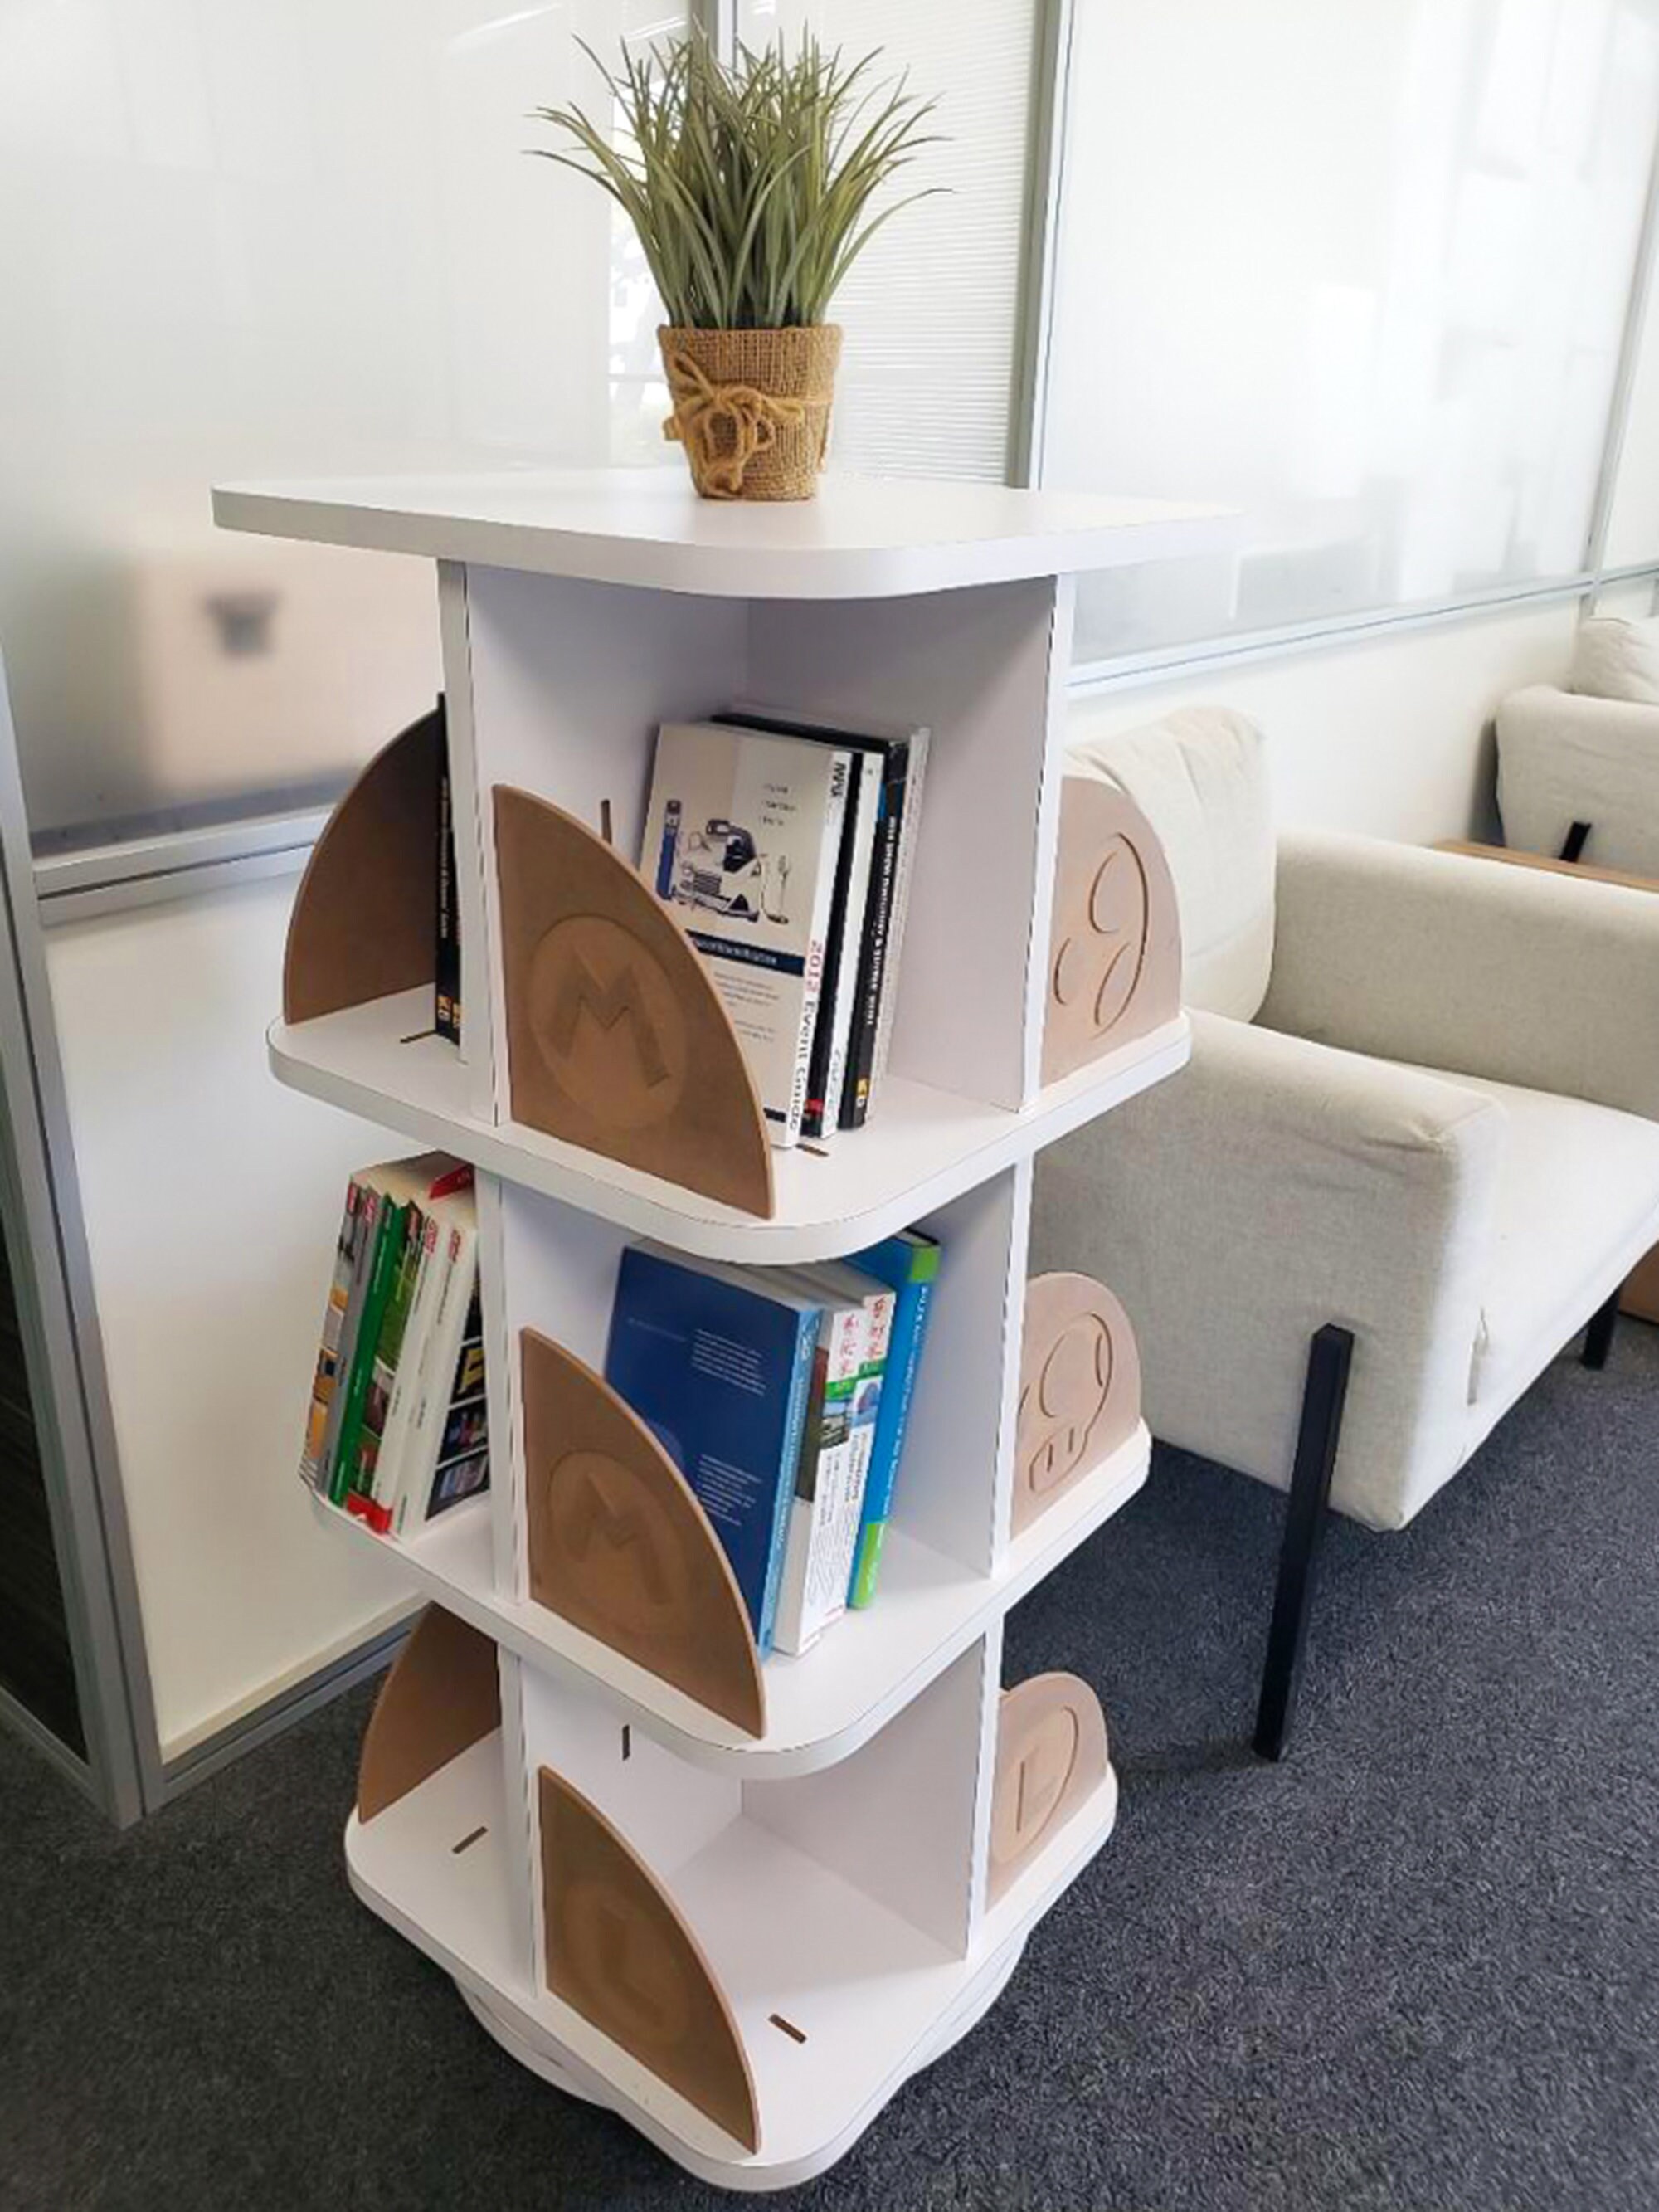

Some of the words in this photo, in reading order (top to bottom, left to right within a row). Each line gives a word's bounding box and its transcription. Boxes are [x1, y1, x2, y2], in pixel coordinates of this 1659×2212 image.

[542, 944, 670, 1088] M
[798, 1001, 815, 1060] Event
[788, 1067, 806, 1131] Guide
[562, 1472, 664, 1605] M
